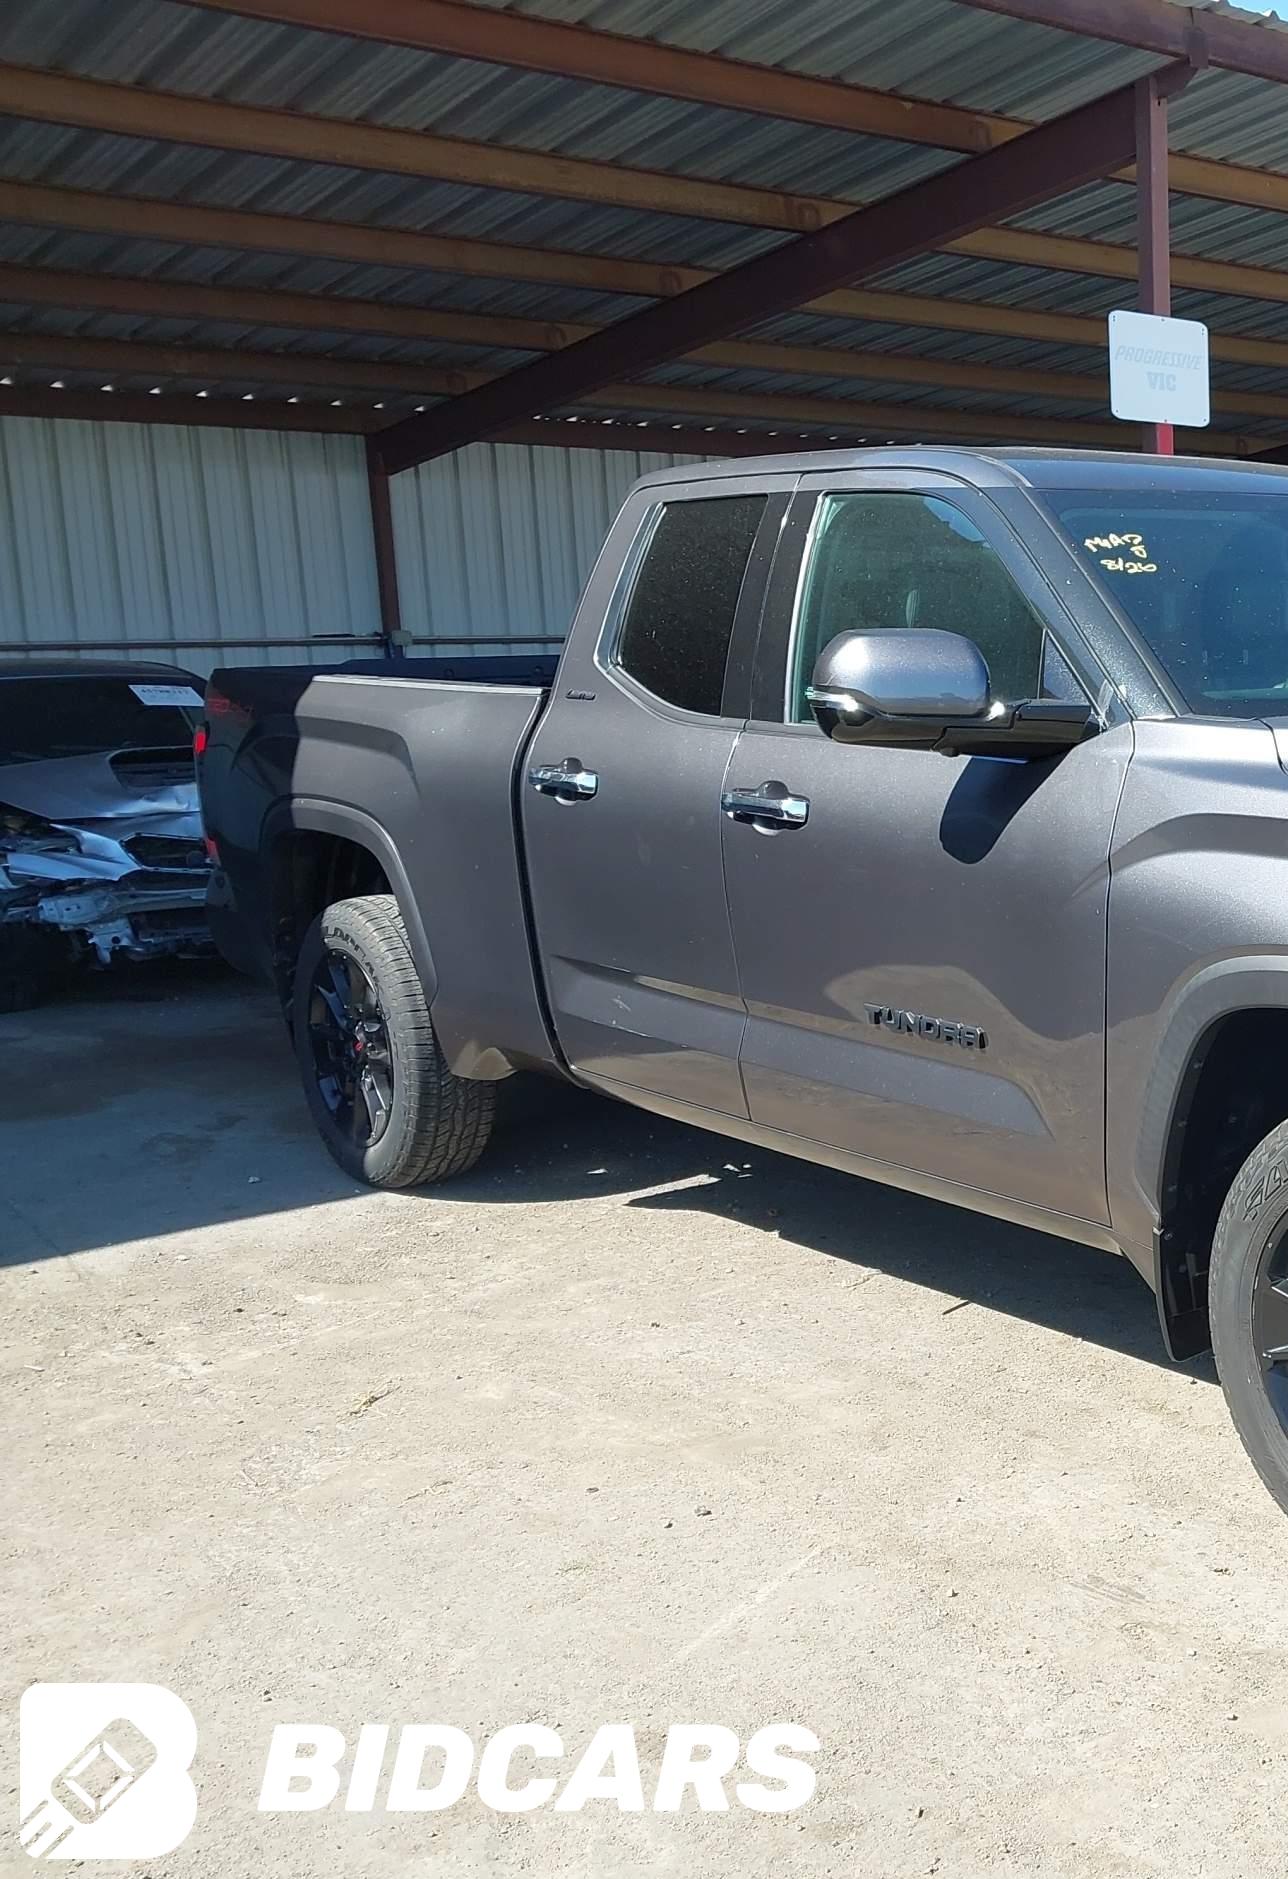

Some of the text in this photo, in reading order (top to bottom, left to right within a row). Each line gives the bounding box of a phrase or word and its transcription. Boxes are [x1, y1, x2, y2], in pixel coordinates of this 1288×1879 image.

[1114, 345, 1204, 370] PROGRESSIVE
[1146, 371, 1177, 392] VIC
[863, 1002, 989, 1052] TUNDRA
